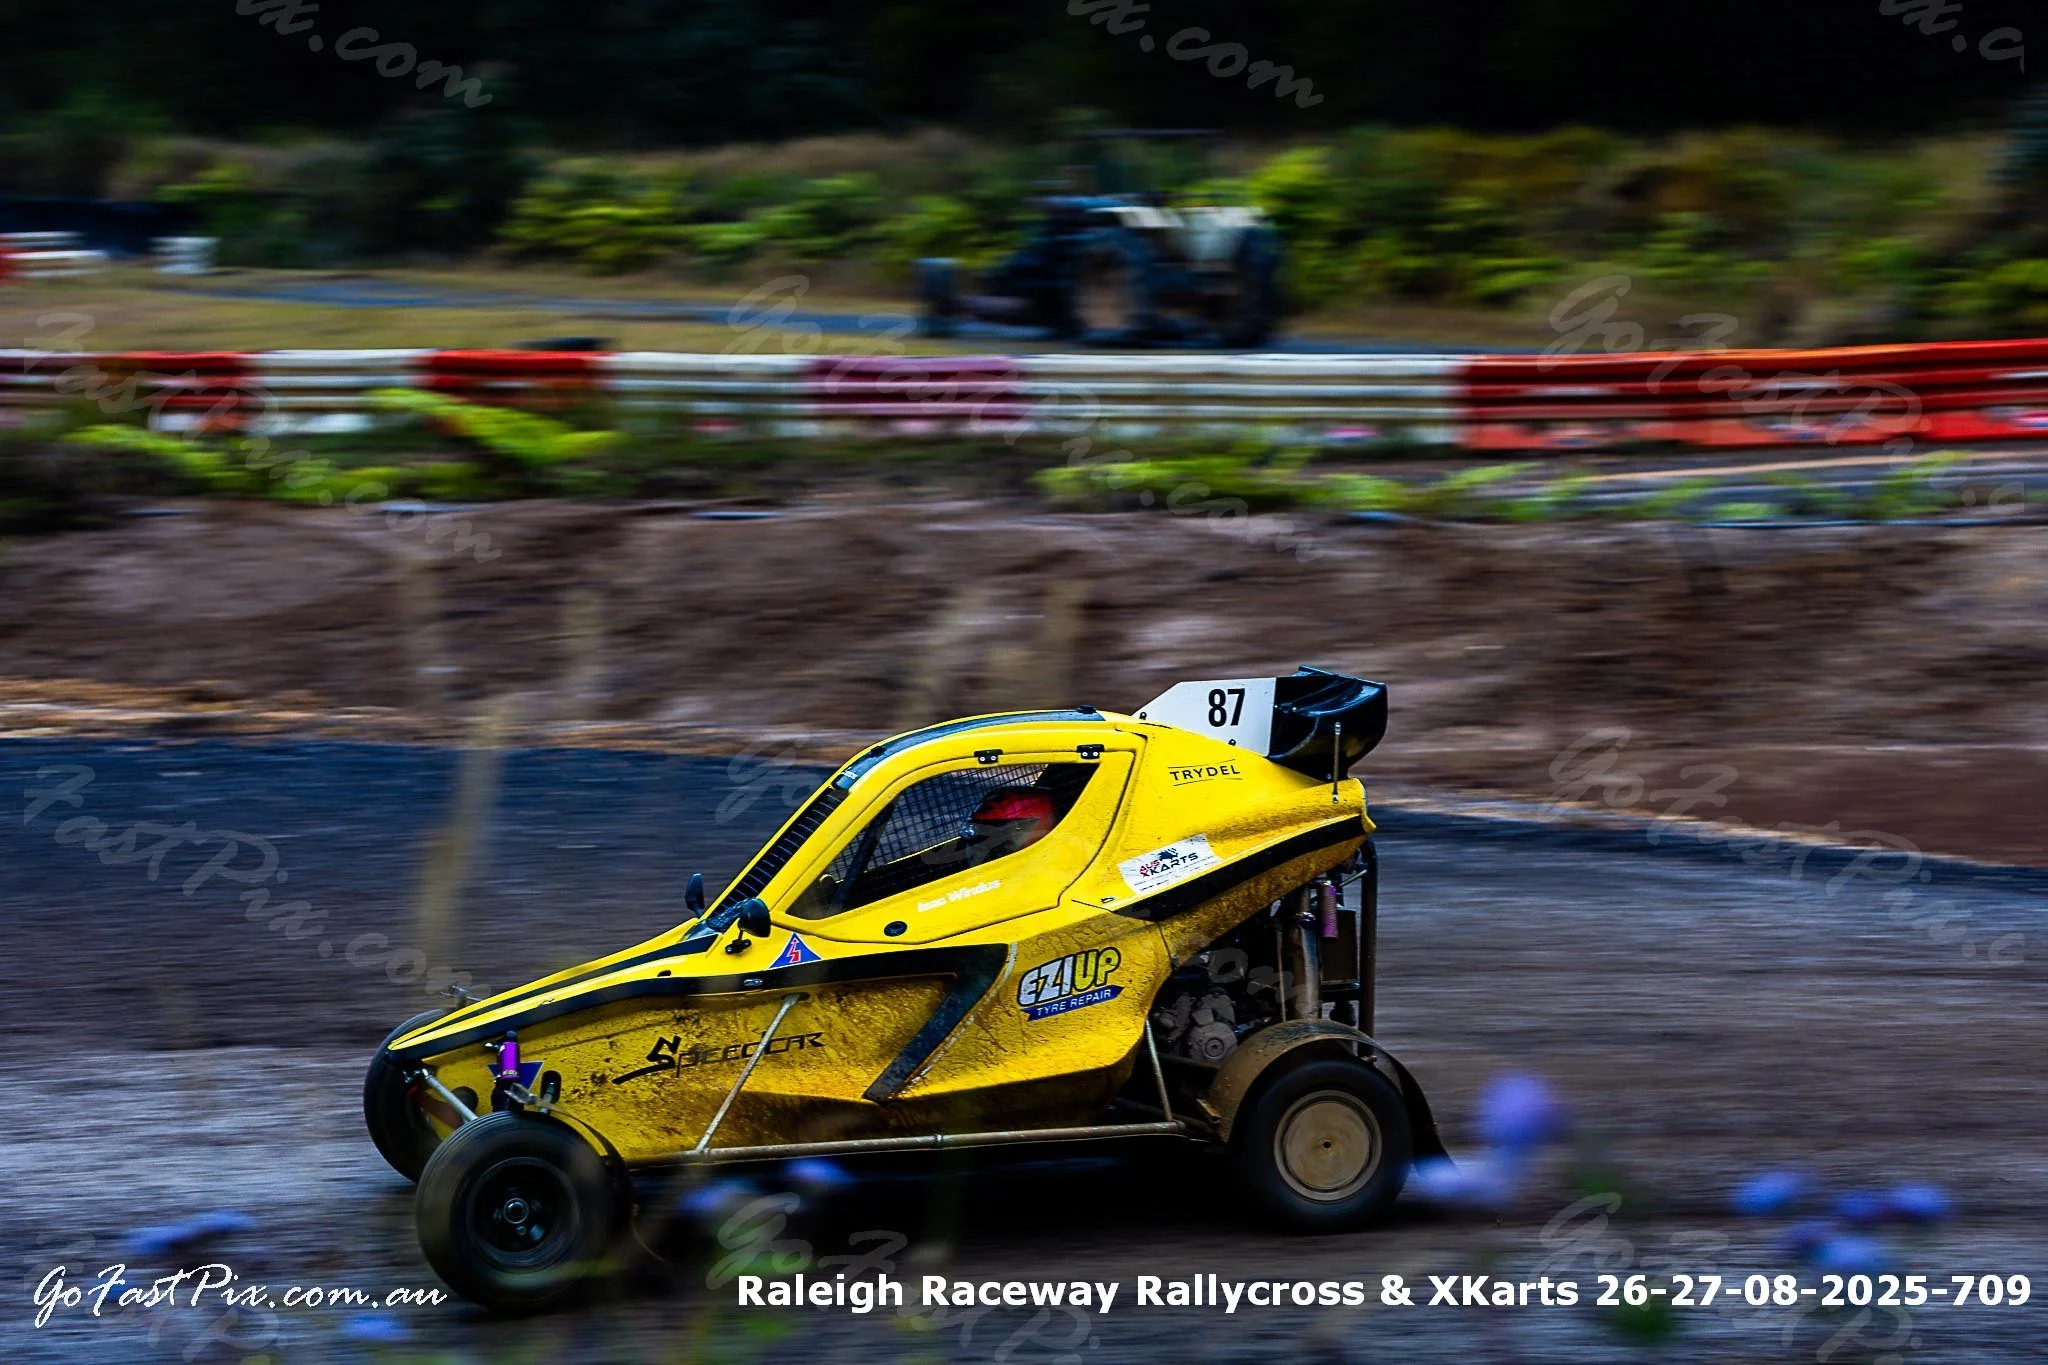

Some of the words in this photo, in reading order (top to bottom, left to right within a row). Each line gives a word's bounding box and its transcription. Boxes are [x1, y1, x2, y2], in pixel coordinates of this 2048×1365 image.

[1208, 688, 1246, 727] 87
[1170, 764, 1241, 782] TRYDEL
[1140, 859, 1161, 874] AUS
[1036, 1002, 1067, 1017] TYRE
[1069, 988, 1112, 1008] REPAIR
